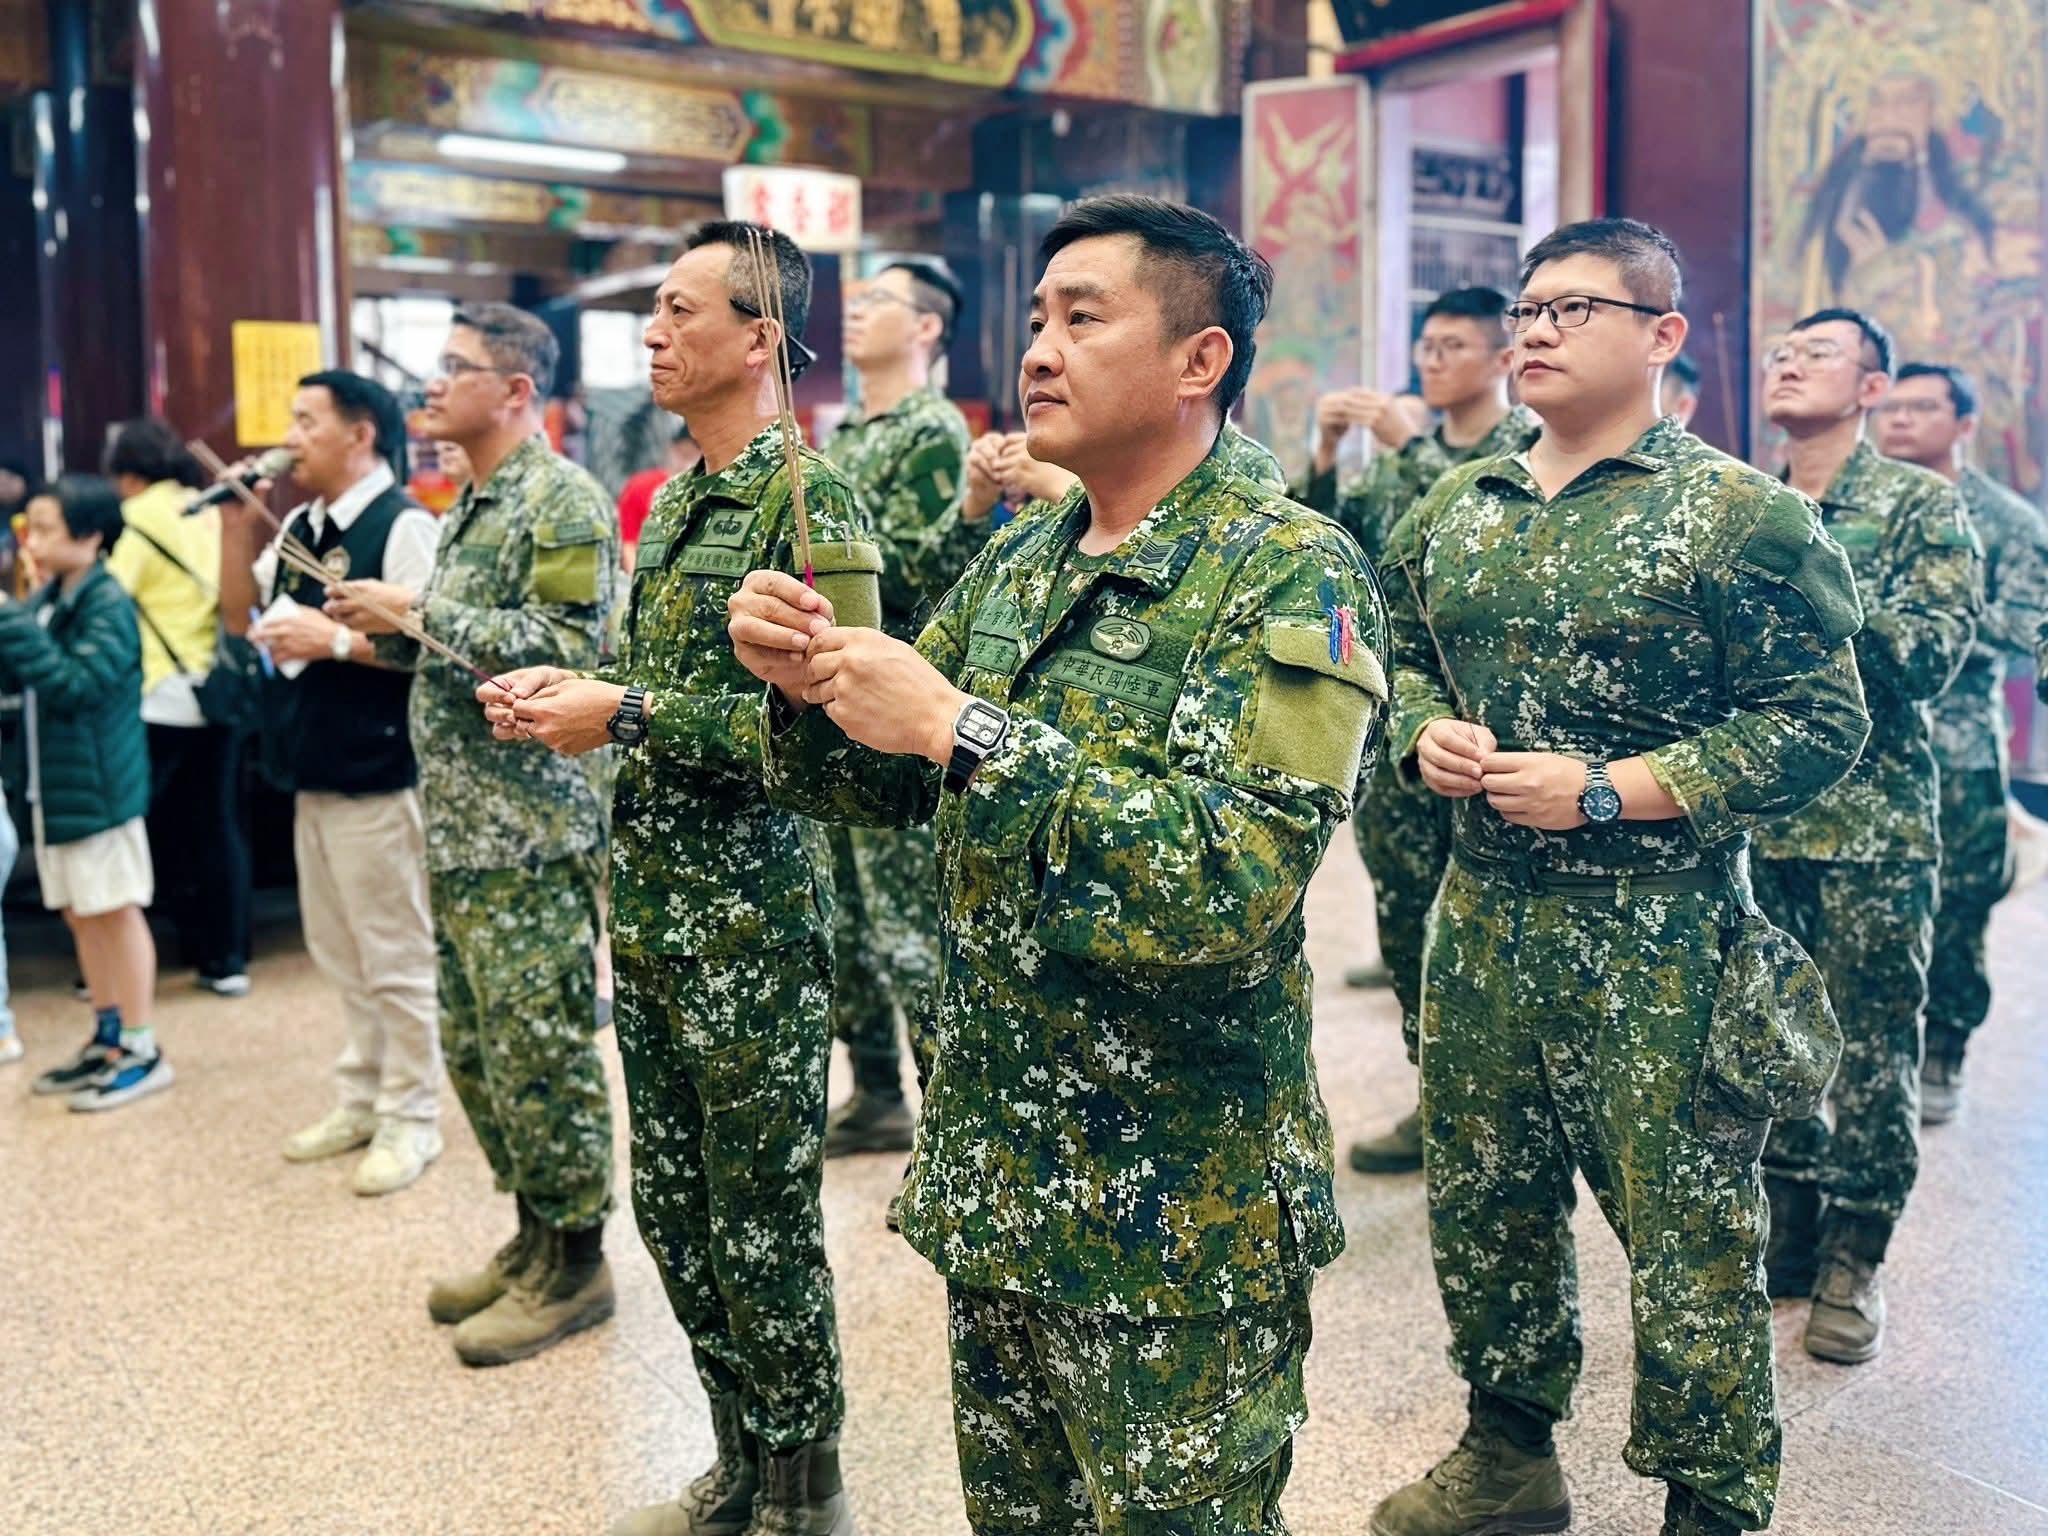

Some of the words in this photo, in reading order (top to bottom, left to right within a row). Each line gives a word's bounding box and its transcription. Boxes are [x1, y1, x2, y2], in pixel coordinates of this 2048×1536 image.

[1062, 655, 1162, 703] 中華民國陸軍
